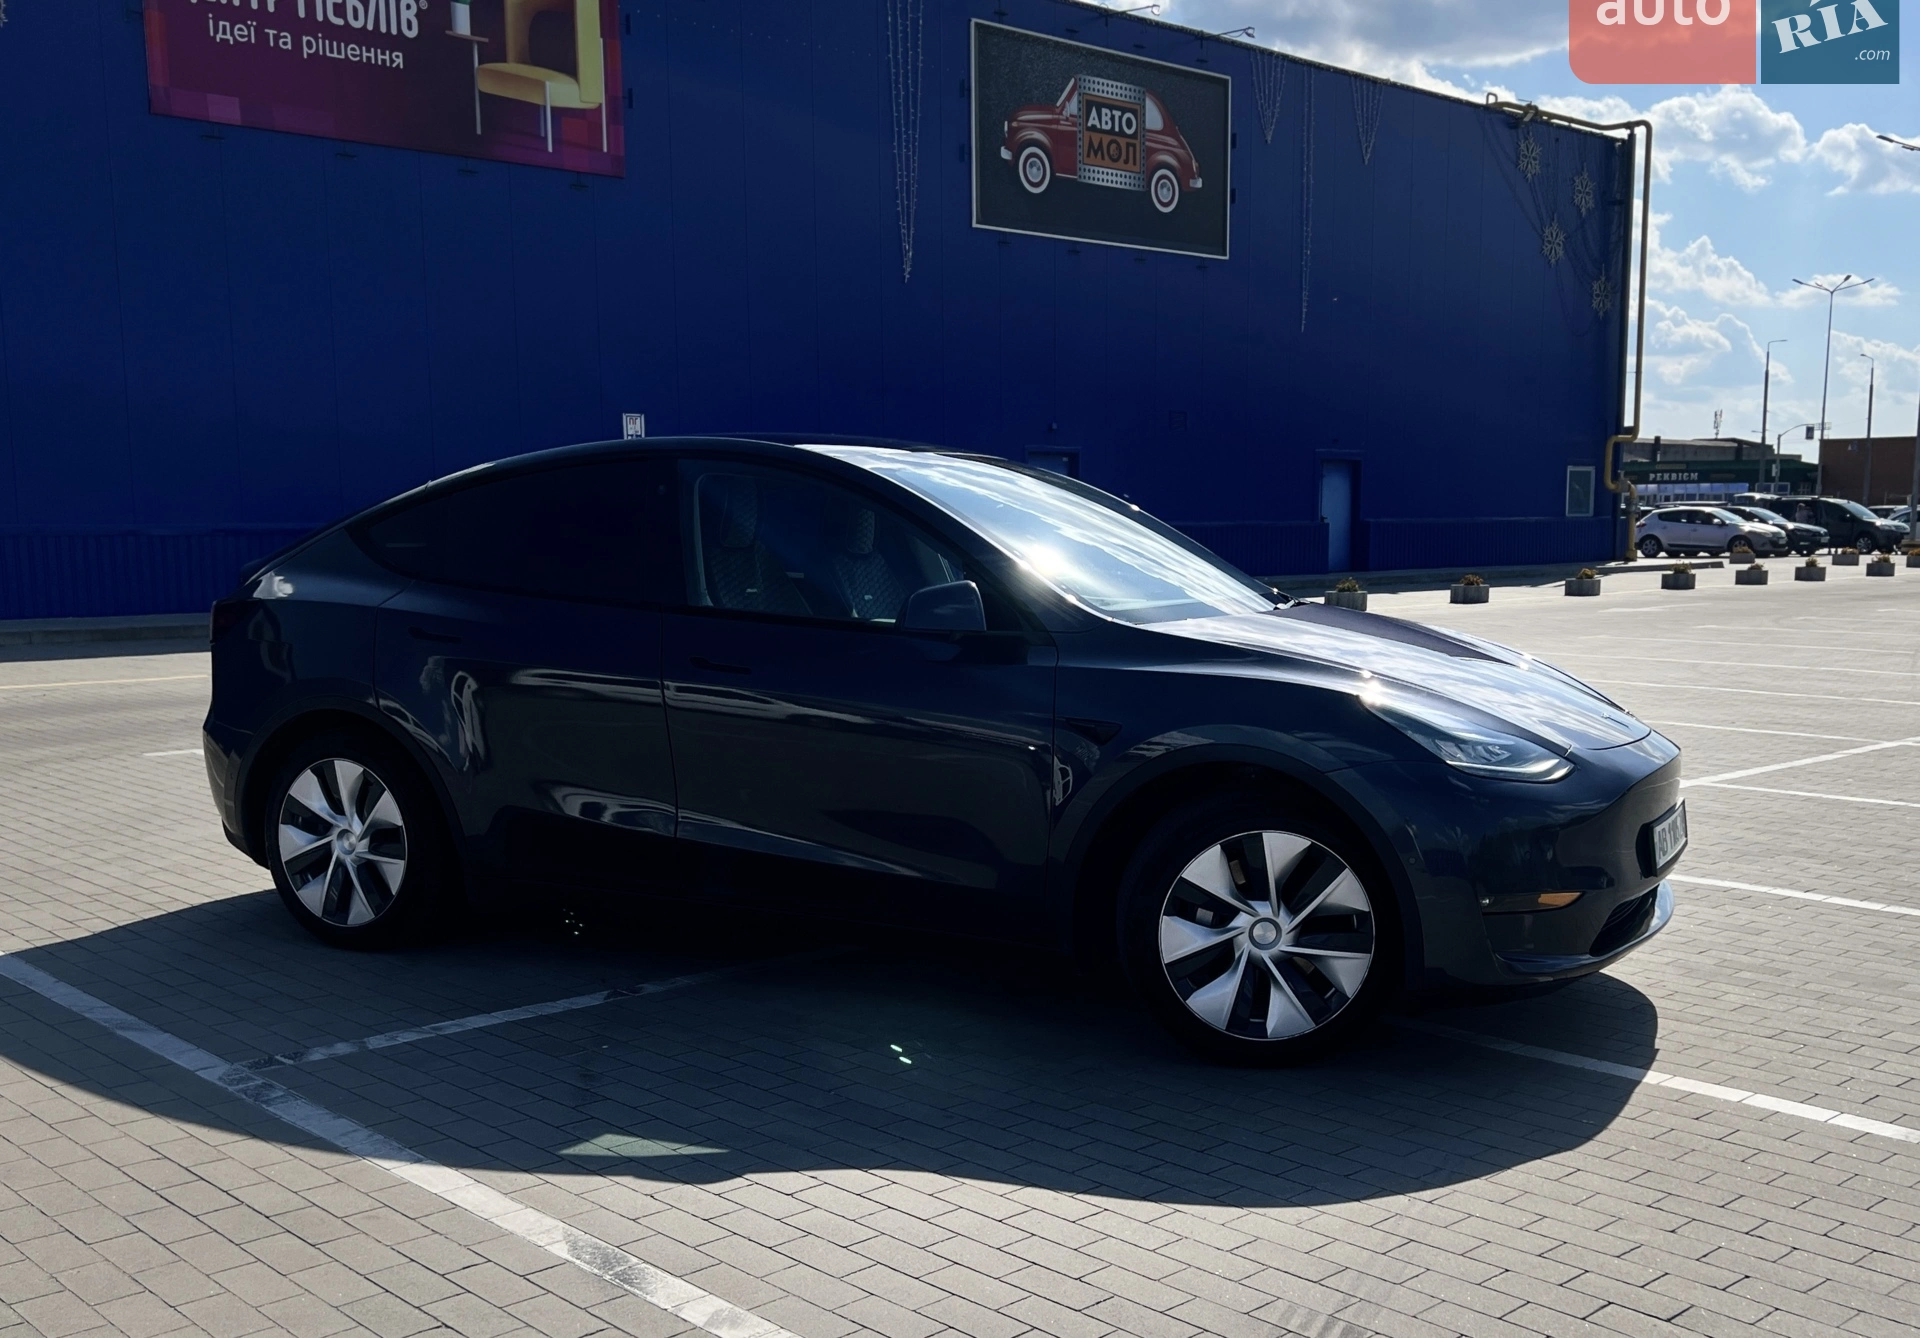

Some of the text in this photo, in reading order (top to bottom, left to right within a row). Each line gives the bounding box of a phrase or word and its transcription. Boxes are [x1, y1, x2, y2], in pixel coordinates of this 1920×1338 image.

[208, 13, 404, 69] ідеї та рішення
[1087, 105, 1137, 135] АВТО
[1086, 134, 1137, 166] МОЛ
